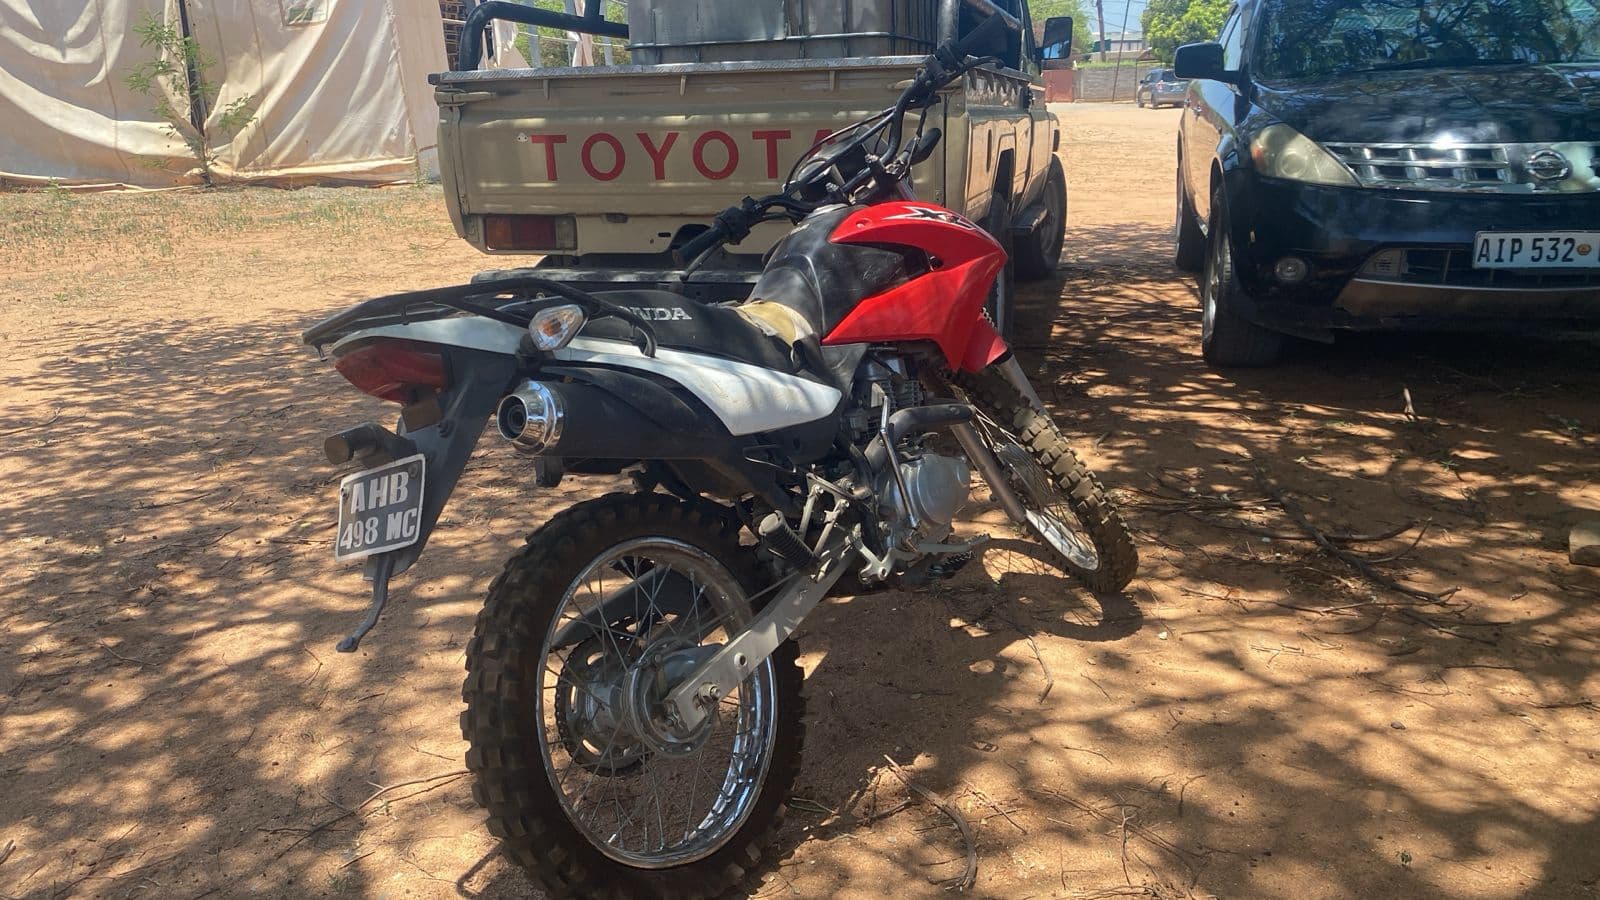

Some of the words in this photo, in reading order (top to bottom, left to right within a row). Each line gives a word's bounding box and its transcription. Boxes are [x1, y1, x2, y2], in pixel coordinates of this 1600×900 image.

[1477, 238, 1523, 262] AIP
[1531, 237, 1576, 262] 532
[619, 305, 692, 320] NDA
[350, 471, 409, 514] AHB
[340, 517, 379, 549] 498
[386, 507, 418, 541] MC
